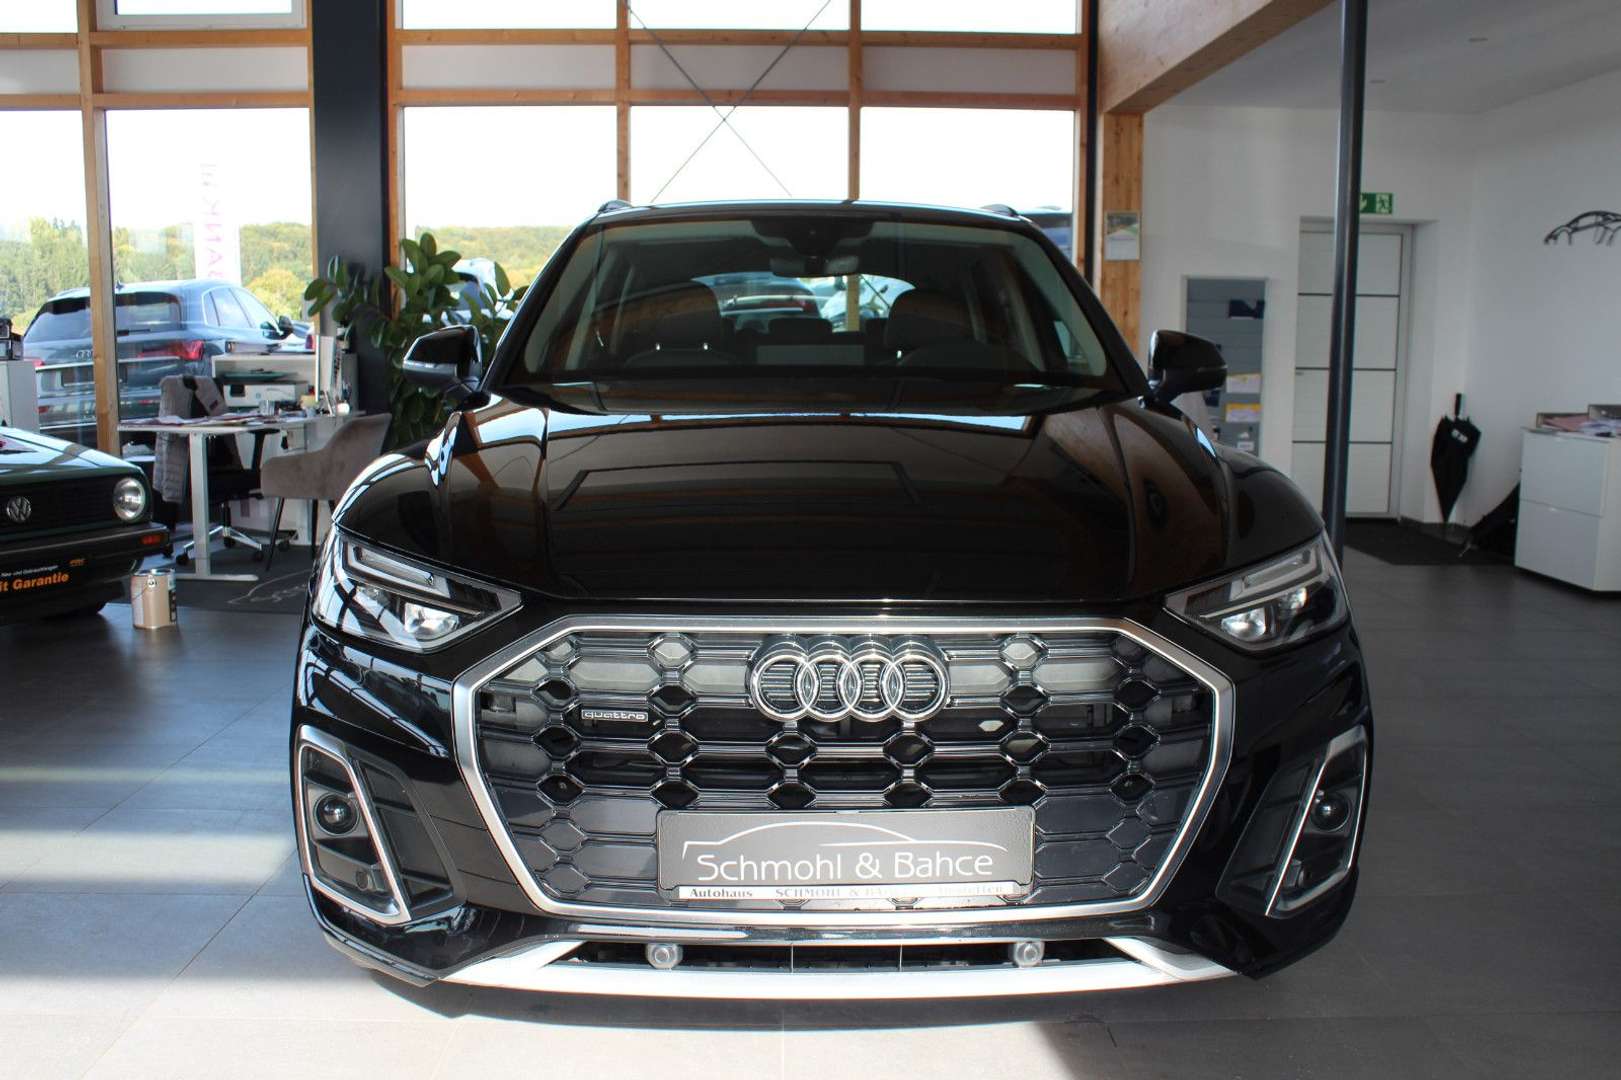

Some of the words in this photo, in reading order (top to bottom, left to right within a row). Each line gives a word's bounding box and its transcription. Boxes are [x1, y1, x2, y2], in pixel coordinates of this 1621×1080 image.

[12, 572, 70, 590] Garantie
[583, 710, 646, 720] quattro
[697, 853, 841, 881] Schmohl
[855, 852, 882, 879] &
[894, 850, 993, 879] Bahce
[690, 887, 753, 898] Autohaus
